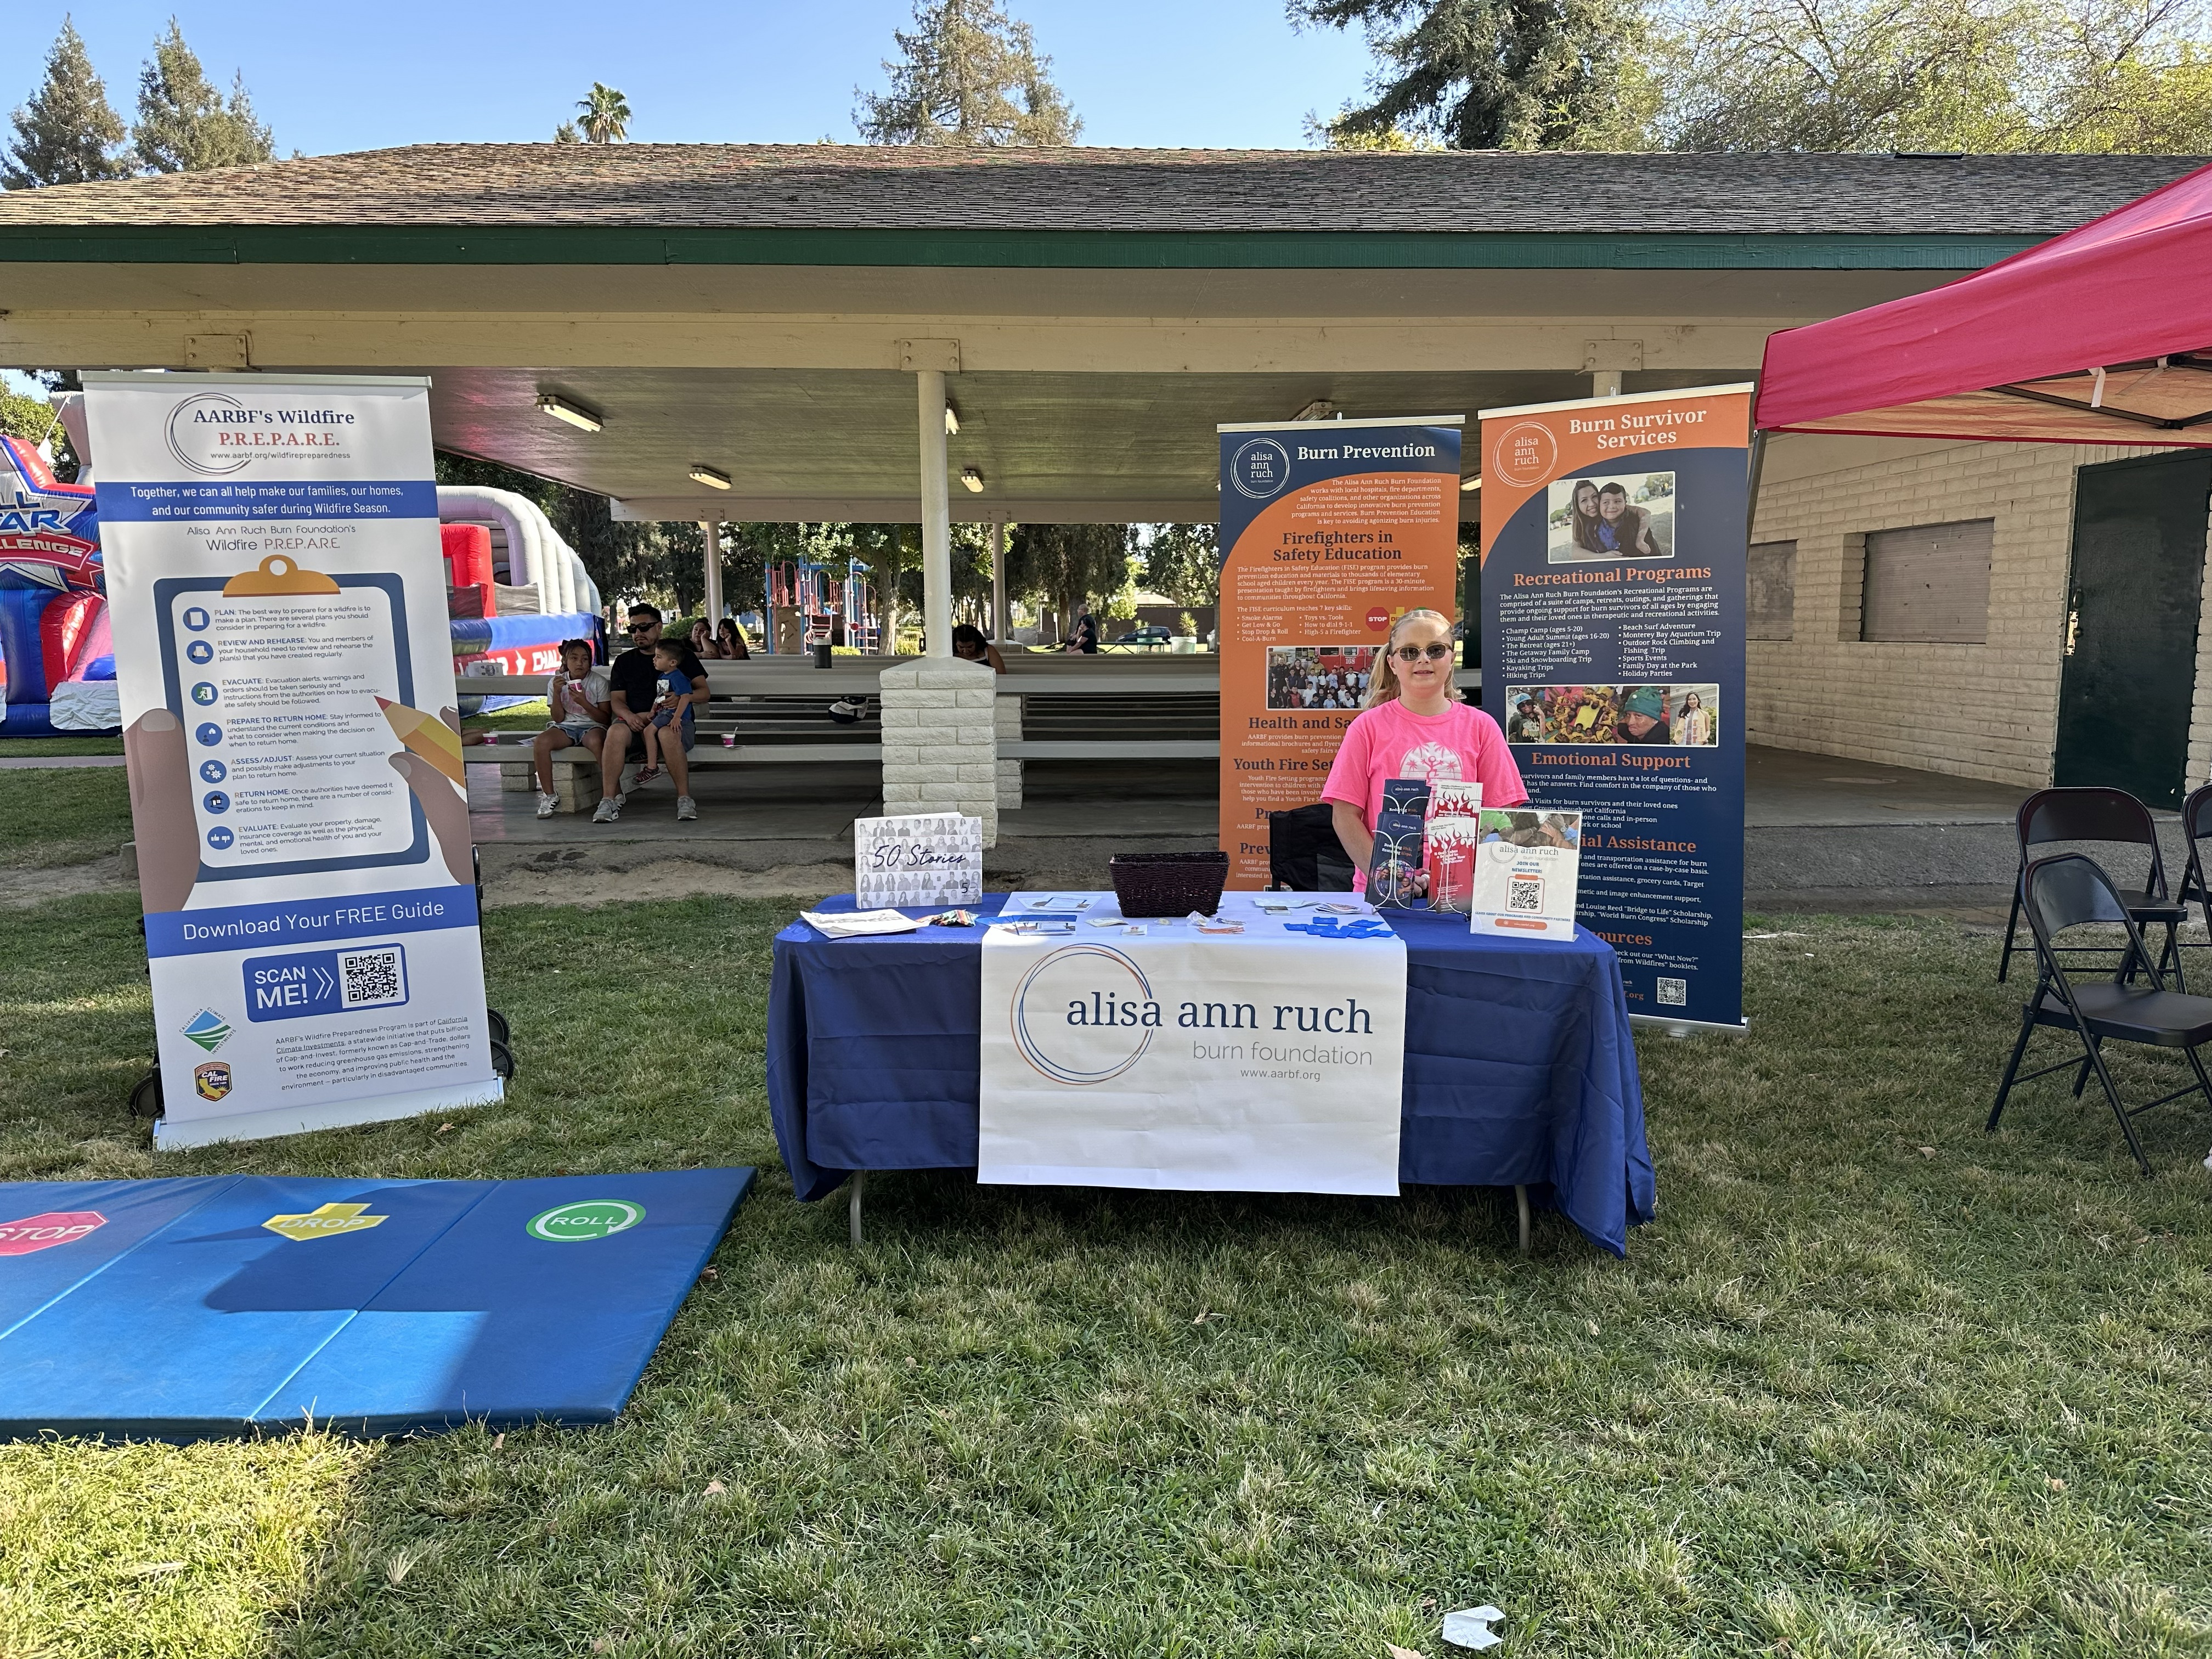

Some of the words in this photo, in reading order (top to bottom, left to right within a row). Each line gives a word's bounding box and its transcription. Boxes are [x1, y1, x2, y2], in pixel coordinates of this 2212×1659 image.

[193, 409, 273, 423] AARBF's
[276, 410, 354, 424] Wildfire
[1569, 419, 1615, 433] Burn
[1621, 410, 1707, 428] Survivor
[218, 432, 340, 445] P.R.E.P.A.R.E.
[1515, 437, 1538, 447] alisa
[1597, 431, 1677, 449] Services
[210, 452, 350, 460] www.aarbf.org/wildfirepreparedness
[1251, 452, 1273, 461] alisa
[1297, 447, 1338, 459] Burn
[1342, 443, 1435, 458] Prevention
[1515, 447, 1534, 456] ann
[1515, 455, 1539, 465] ruch
[1251, 468, 1273, 478] ruch
[130, 487, 179, 499] Together,
[182, 488, 196, 496] we
[221, 486, 232, 496] all
[235, 486, 256, 498] help
[259, 486, 285, 496] make
[307, 485, 348, 496] families,
[369, 485, 403, 496] homes,
[152, 505, 171, 515] and
[193, 504, 249, 516] community
[252, 504, 278, 514] safer
[280, 503, 312, 516] during
[314, 503, 351, 513] Wildfire
[353, 503, 390, 512] Season.
[0, 511, 64, 532] AR
[187, 527, 210, 535] Alisa
[216, 526, 236, 534] Ann
[240, 526, 266, 534] Ruch
[296, 524, 356, 533] Foundation's
[205, 539, 257, 550] Wildfire
[264, 537, 340, 549] P.R.E.P.A.R.E.
[1282, 531, 1373, 546] Firefighters
[1378, 530, 1393, 543] in
[0, 539, 86, 557] LENGE
[1273, 548, 1321, 563] Safety
[1324, 546, 1402, 560] Education
[1513, 568, 1621, 586] Recreational
[1626, 567, 1711, 583] Programs
[1249, 716, 1297, 729] Health
[1302, 716, 1330, 729] and
[231, 755, 295, 764] ASSESS/ADJUST:
[1233, 758, 1274, 770] Youth
[1279, 758, 1308, 770] Fire
[1531, 752, 1617, 765] Emotional
[1622, 753, 1690, 770] Support
[238, 823, 278, 832] EVALUATE:
[1606, 836, 1696, 852] Assistance
[873, 844, 901, 868] 50
[907, 844, 966, 866] Stories
[183, 916, 280, 939] Download
[285, 914, 330, 929] Your
[335, 905, 386, 925] FREE
[392, 901, 443, 919] Guide
[1595, 932, 1652, 945] ources
[255, 966, 306, 984] SCAN
[256, 983, 308, 1008] ME!
[179, 1008, 204, 1033] CALIFORNIA
[207, 1007, 227, 1022] CLIMATE
[1066, 992, 1163, 1028] alisa
[1177, 1003, 1259, 1029] ann
[1272, 998, 1373, 1035] ruch
[211, 1029, 236, 1055] INVESTMENTS
[1193, 1041, 1243, 1060] burn
[1251, 1041, 1372, 1065] foundation
[1240, 1069, 1321, 1082] www.aarbf.org
[280, 1217, 366, 1228] DROP
[550, 1216, 618, 1226] ROLL
[0, 1225, 94, 1241] STOP
